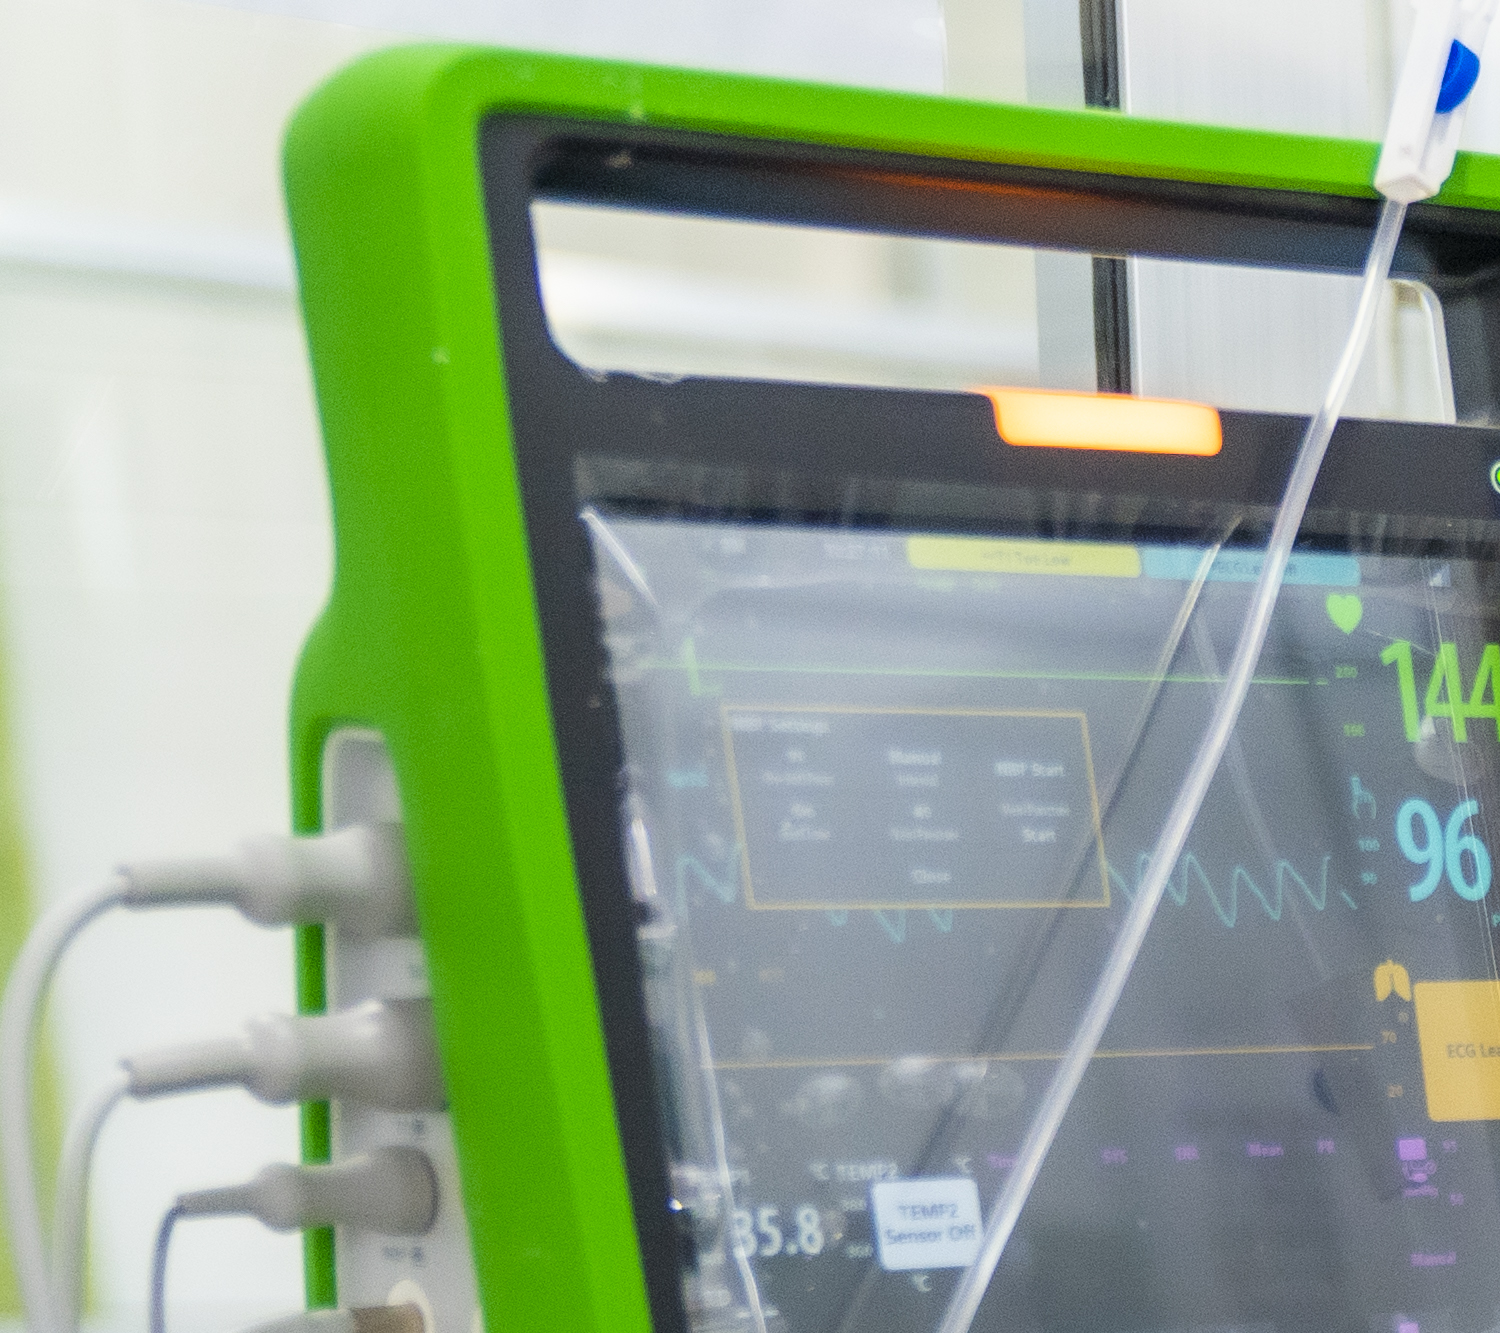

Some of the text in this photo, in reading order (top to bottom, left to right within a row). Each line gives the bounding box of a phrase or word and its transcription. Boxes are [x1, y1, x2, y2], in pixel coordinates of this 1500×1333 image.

[1396, 798, 1492, 902] 96
[1447, 1043, 1476, 1059] ECG
[897, 1203, 960, 1222] TEMP2
[884, 1227, 943, 1246] Sensor
